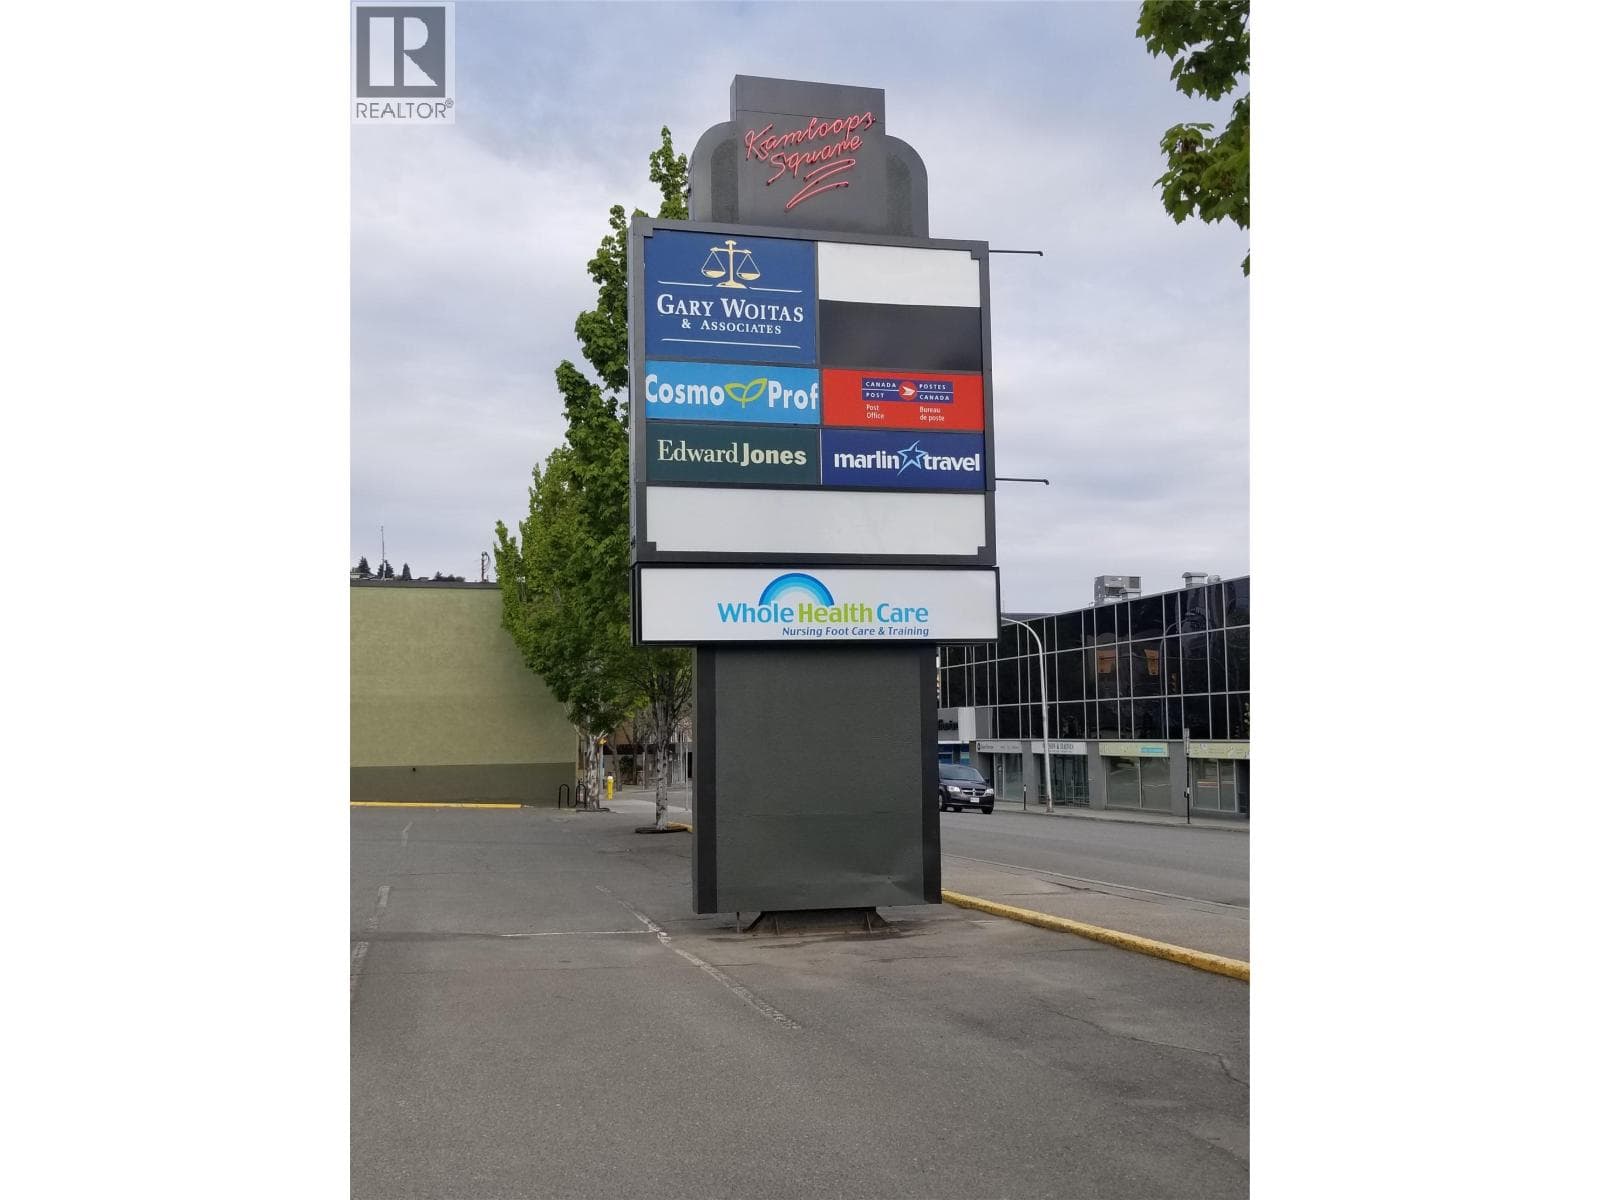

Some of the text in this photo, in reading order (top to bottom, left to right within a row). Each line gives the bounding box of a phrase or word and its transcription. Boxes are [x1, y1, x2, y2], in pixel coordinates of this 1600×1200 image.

[744, 111, 876, 160] Kamloops
[767, 135, 863, 185] Square
[681, 318, 691, 329] &
[645, 373, 818, 410] Cosmo Prof
[866, 412, 885, 420] Office
[919, 406, 941, 414] Bureau
[928, 414, 945, 422] poste
[657, 439, 807, 467] Edward Jones
[834, 450, 981, 472] marlin travel
[717, 602, 929, 624] Whole Health Care
[782, 626, 929, 637] Nursing Foot Care & Training
